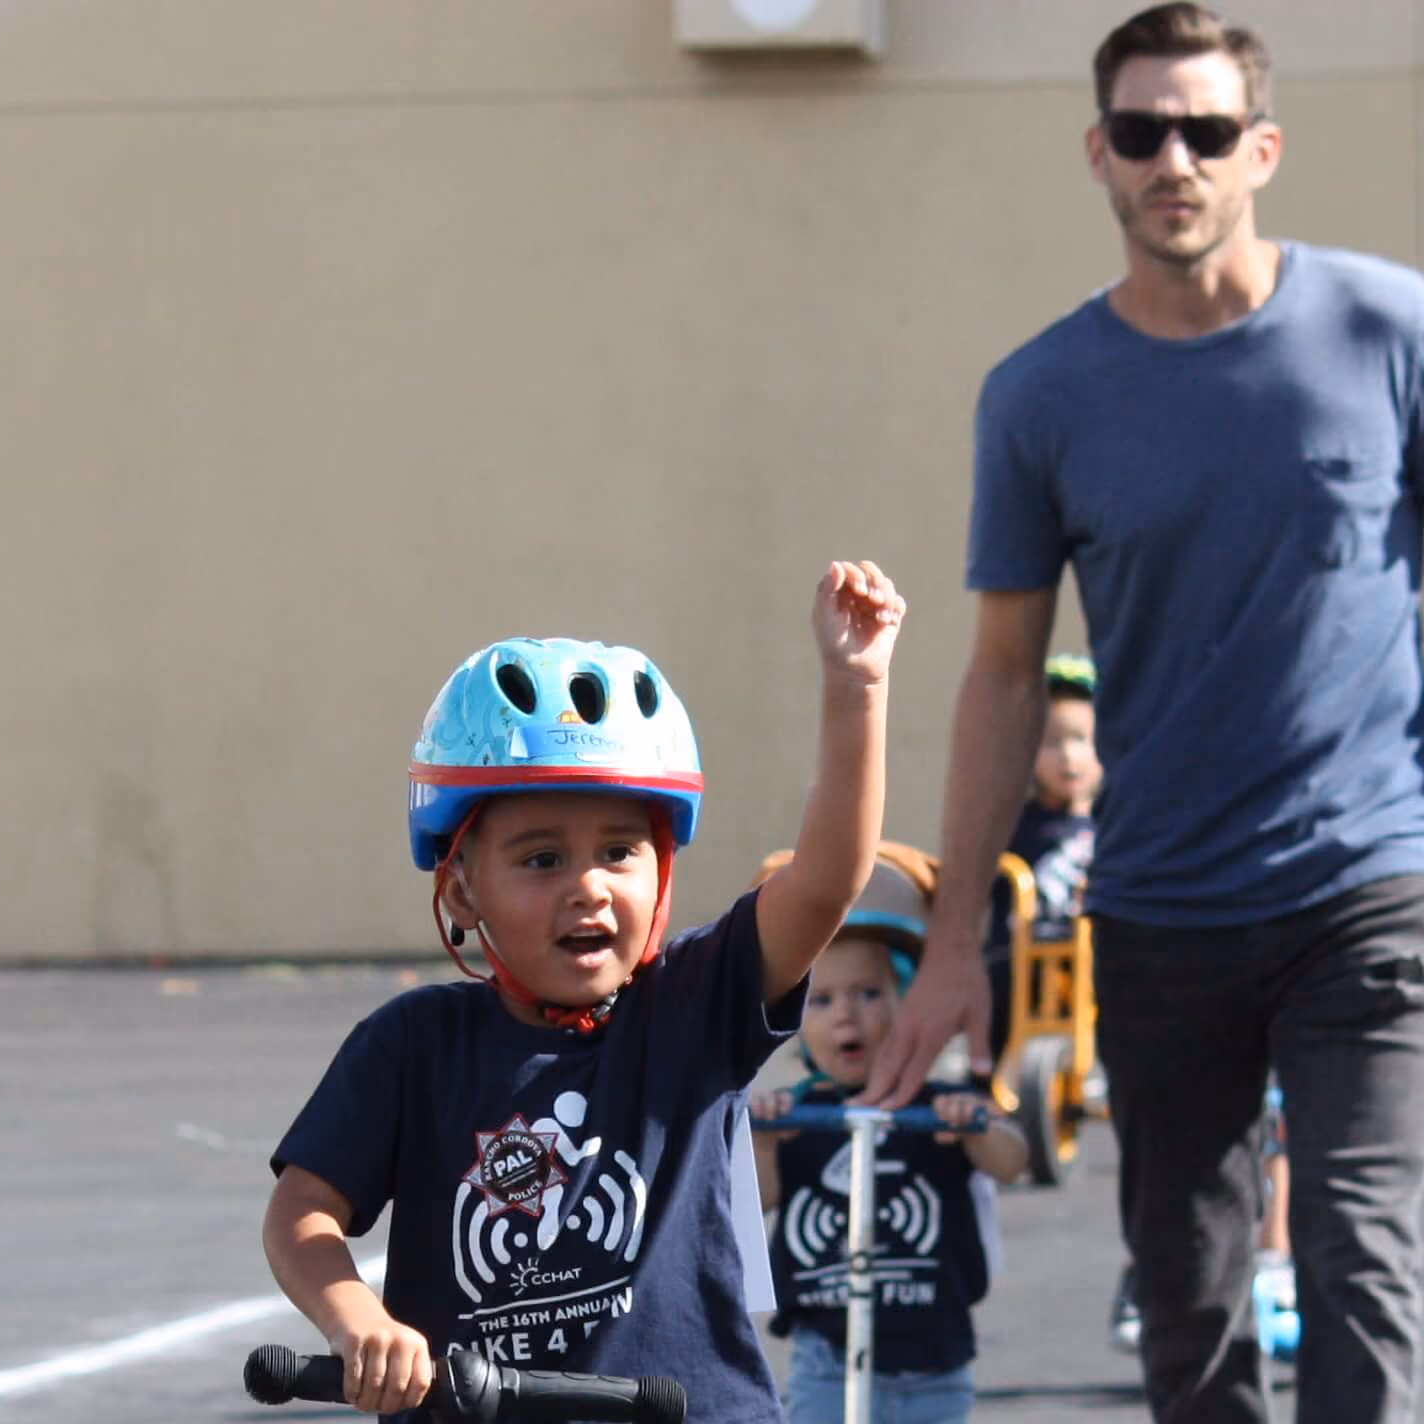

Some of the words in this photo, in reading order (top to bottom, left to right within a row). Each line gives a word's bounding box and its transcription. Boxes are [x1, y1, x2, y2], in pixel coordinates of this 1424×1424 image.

[493, 1150, 533, 1178] PAL
[508, 1179, 543, 1201] POLICE
[531, 1268, 582, 1286] CCHAT
[479, 1317, 509, 1333] THE
[513, 1311, 551, 1328] 16TH
[555, 1297, 611, 1321] ANNUA
[547, 1328, 569, 1354] 4
